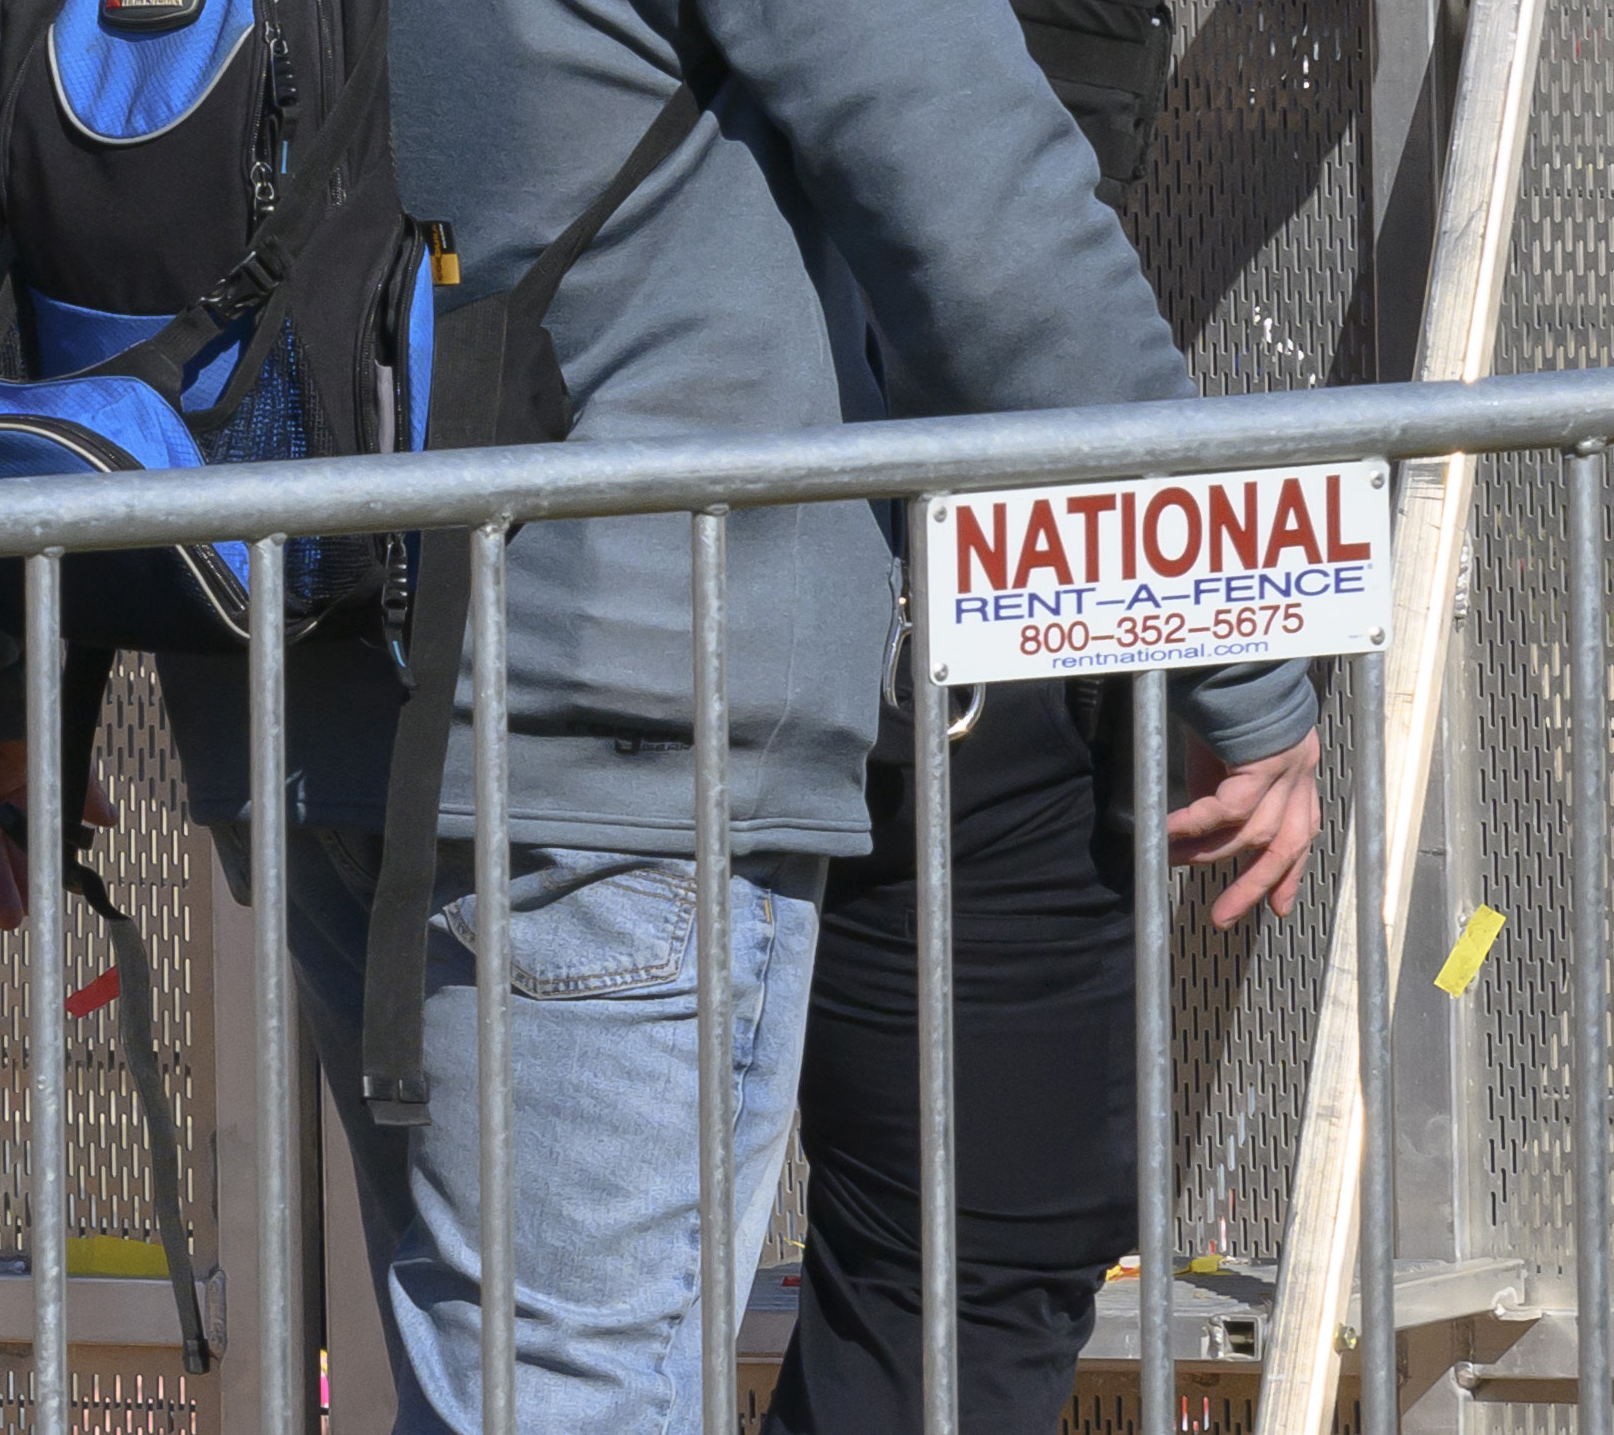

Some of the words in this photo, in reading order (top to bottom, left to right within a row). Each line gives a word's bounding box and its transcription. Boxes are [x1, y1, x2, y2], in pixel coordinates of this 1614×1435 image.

[956, 475, 1372, 594] NATIONAL
[954, 565, 1366, 625] RENT-A-FENCE
[1018, 603, 1305, 656] 800-352-5675
[1051, 640, 1269, 670] rentnational.com
